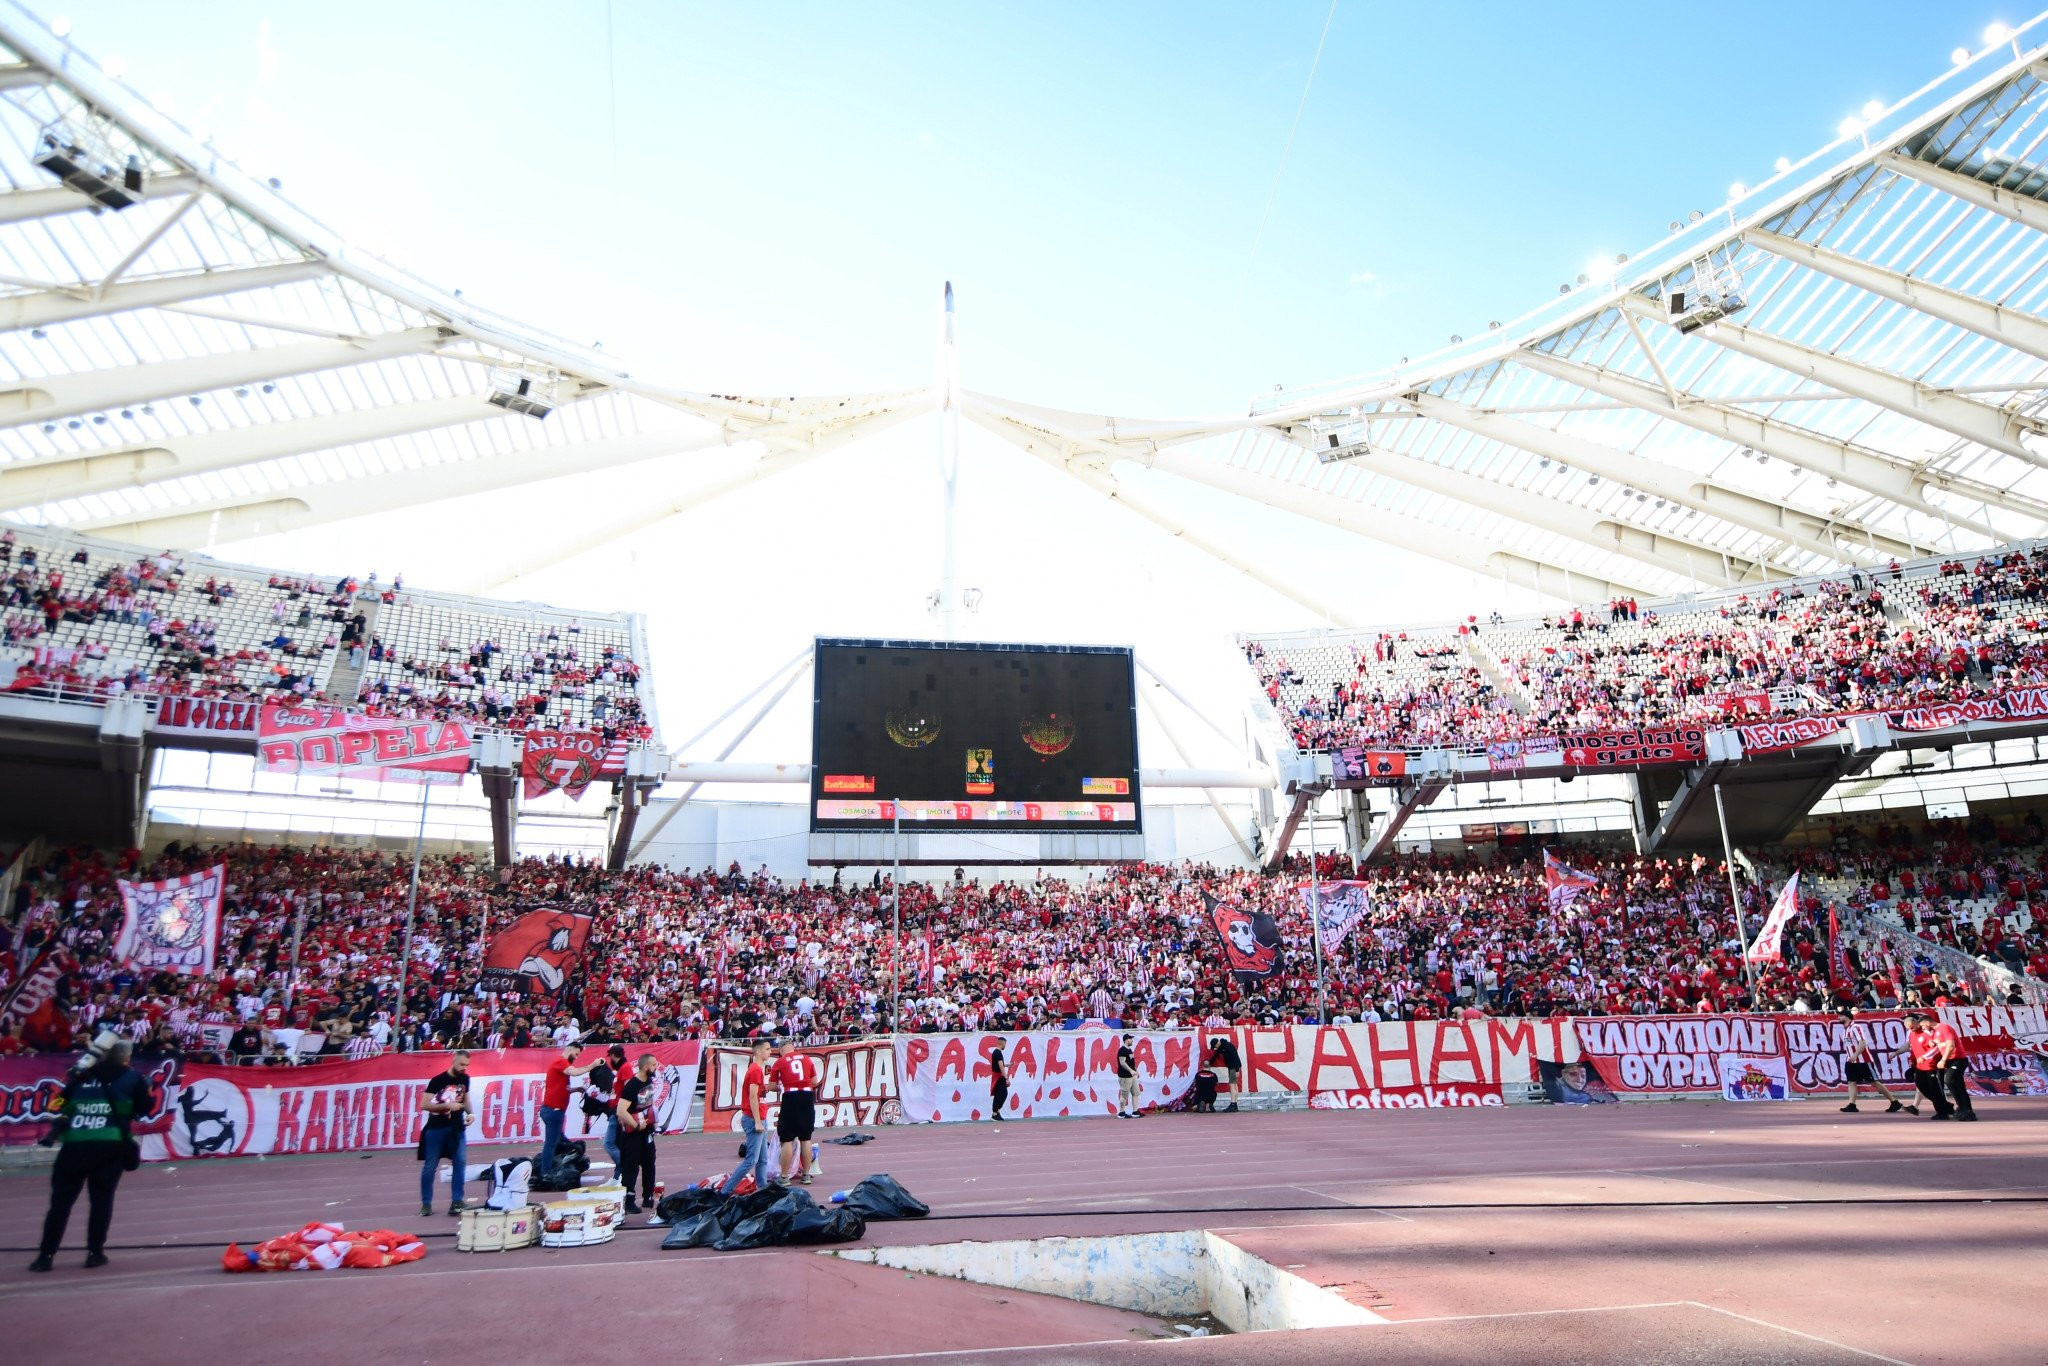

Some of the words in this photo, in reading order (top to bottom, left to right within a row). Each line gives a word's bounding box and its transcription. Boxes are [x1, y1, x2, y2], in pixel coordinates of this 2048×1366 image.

[158, 697, 256, 731] ΑΜΦΙΣΣΑ
[2006, 688, 2048, 717] ΜΑ
[274, 709, 315, 727] Gate
[320, 713, 333, 728] 7
[261, 722, 471, 773] ΒΟΡΕΙΑ
[528, 735, 608, 760] ARGOS
[1556, 728, 1703, 749] moschato
[1596, 746, 1673, 764] gate
[549, 759, 580, 788] 7
[1576, 1020, 1777, 1054] ΗΛΙΟΥΠΟΛΗ
[790, 1060, 804, 1080] 9
[1621, 1053, 1720, 1088] ΘΥΡΑ
[481, 1078, 550, 1139] GAT
[1324, 1086, 1504, 1109] Nafpaktos
